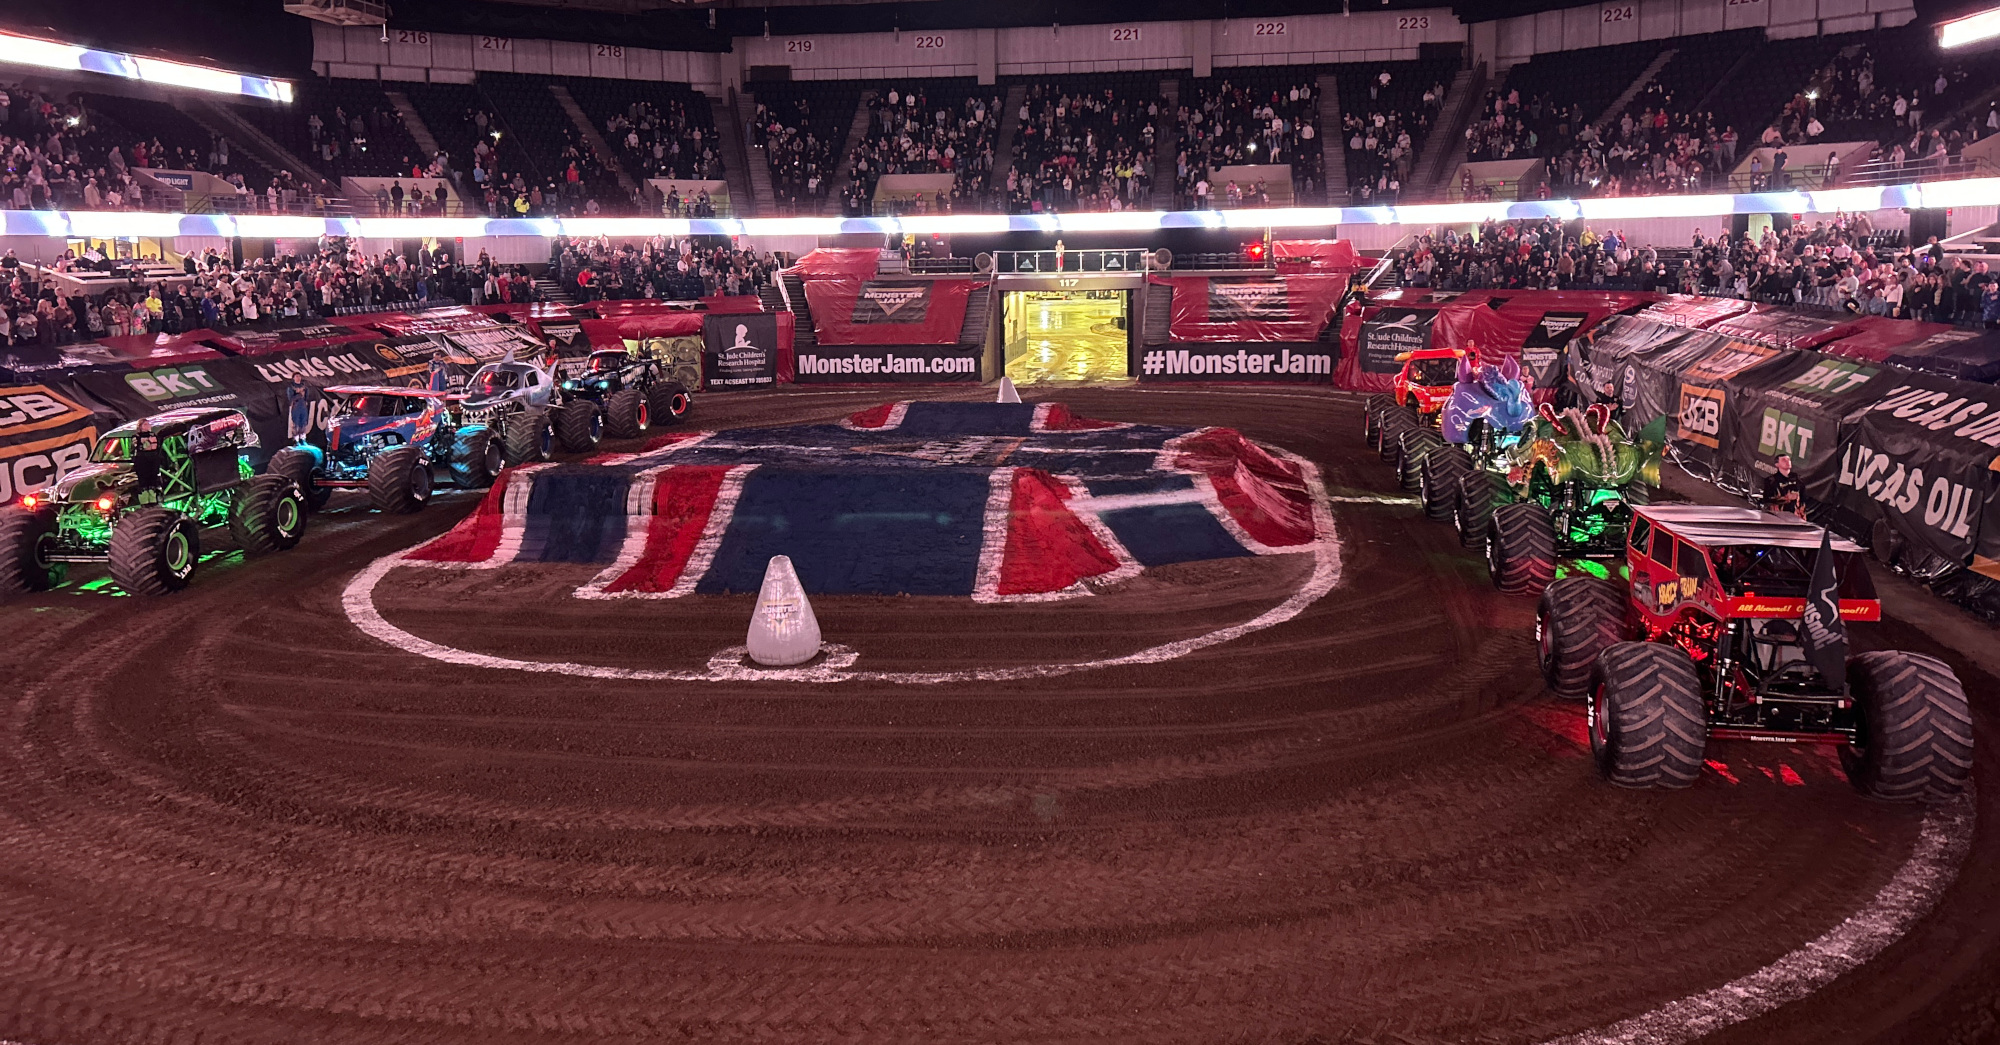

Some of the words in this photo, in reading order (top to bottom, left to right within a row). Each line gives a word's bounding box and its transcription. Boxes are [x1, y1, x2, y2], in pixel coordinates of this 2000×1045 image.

[1603, 8, 1633, 22] 224
[1256, 23, 1285, 35] 222
[1398, 17, 1429, 30] 223
[399, 31, 428, 44] 216
[1113, 28, 1139, 41] 221
[482, 37, 509, 50] 217
[788, 40, 812, 52] 219
[916, 36, 944, 49] 220
[597, 45, 622, 57] 218
[171, 178, 189, 186] LIGHT
[1059, 279, 1079, 287] 117
[1215, 287, 1279, 295] MONSTER
[1367, 332, 1376, 341] St.
[1375, 332, 1391, 342] Jude
[1391, 333, 1424, 344] Children's
[1367, 341, 1395, 351] Research
[717, 359, 744, 367] Research
[744, 358, 766, 367] Hospital
[726, 352, 739, 361] Jude
[738, 351, 766, 359] Children's
[1143, 349, 1331, 375] #MonsterJam
[254, 356, 335, 383] LUCAS
[327, 352, 372, 374] OIL
[798, 353, 976, 375] MonsterJam.com
[129, 370, 214, 396] BKT
[1791, 365, 1871, 394] BKT
[197, 393, 238, 406] TOGETHER
[0, 394, 69, 427] CB
[1681, 397, 1719, 436] JCB
[1761, 415, 1813, 460] BKT
[1838, 442, 1924, 515] LUCAS
[1924, 476, 1974, 540] OIL
[1737, 604, 1751, 613] All
[1753, 604, 1792, 613] Aboard!
[1587, 693, 1595, 728] BKT
